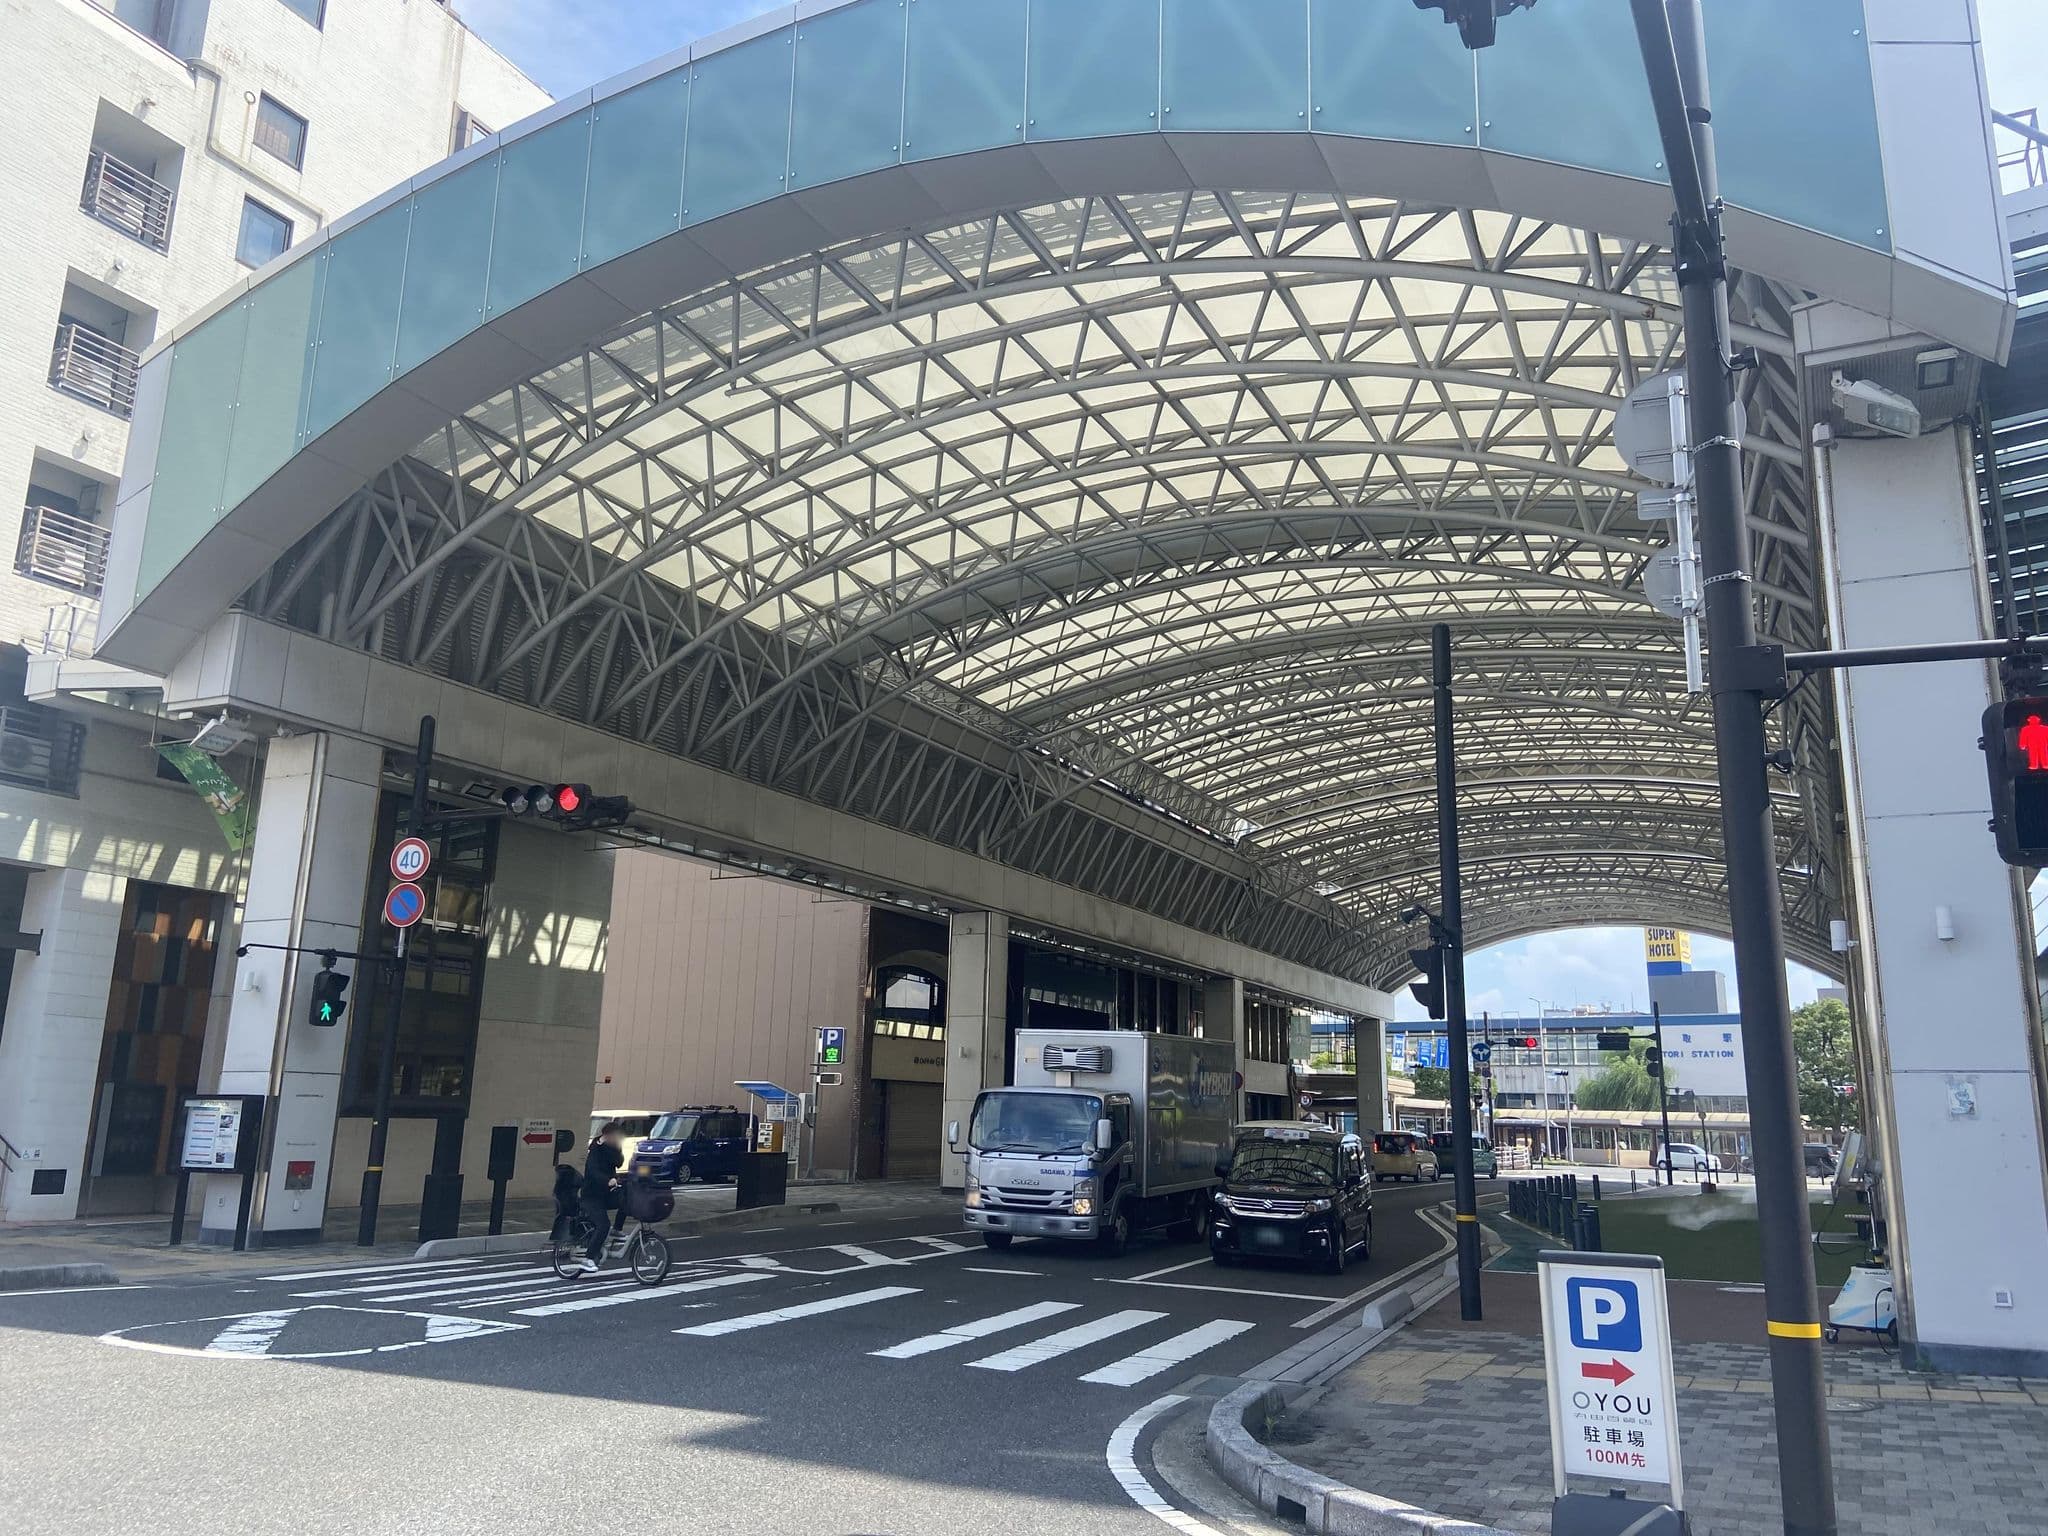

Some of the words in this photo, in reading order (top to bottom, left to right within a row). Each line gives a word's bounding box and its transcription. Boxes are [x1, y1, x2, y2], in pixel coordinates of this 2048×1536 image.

[399, 850, 421, 869] 40
[1648, 928, 1675, 941] SUPER
[1649, 943, 1675, 957] HOTEL
[827, 1030, 838, 1045] P
[1691, 1050, 1734, 1058] STATION
[1040, 1168, 1066, 1176] SAGAWA
[1579, 1286, 1627, 1341] P
[1573, 1391, 1651, 1416] OYOU
[1583, 1425, 1645, 1448] 駐車場
[1586, 1448, 1646, 1468] 100M先
